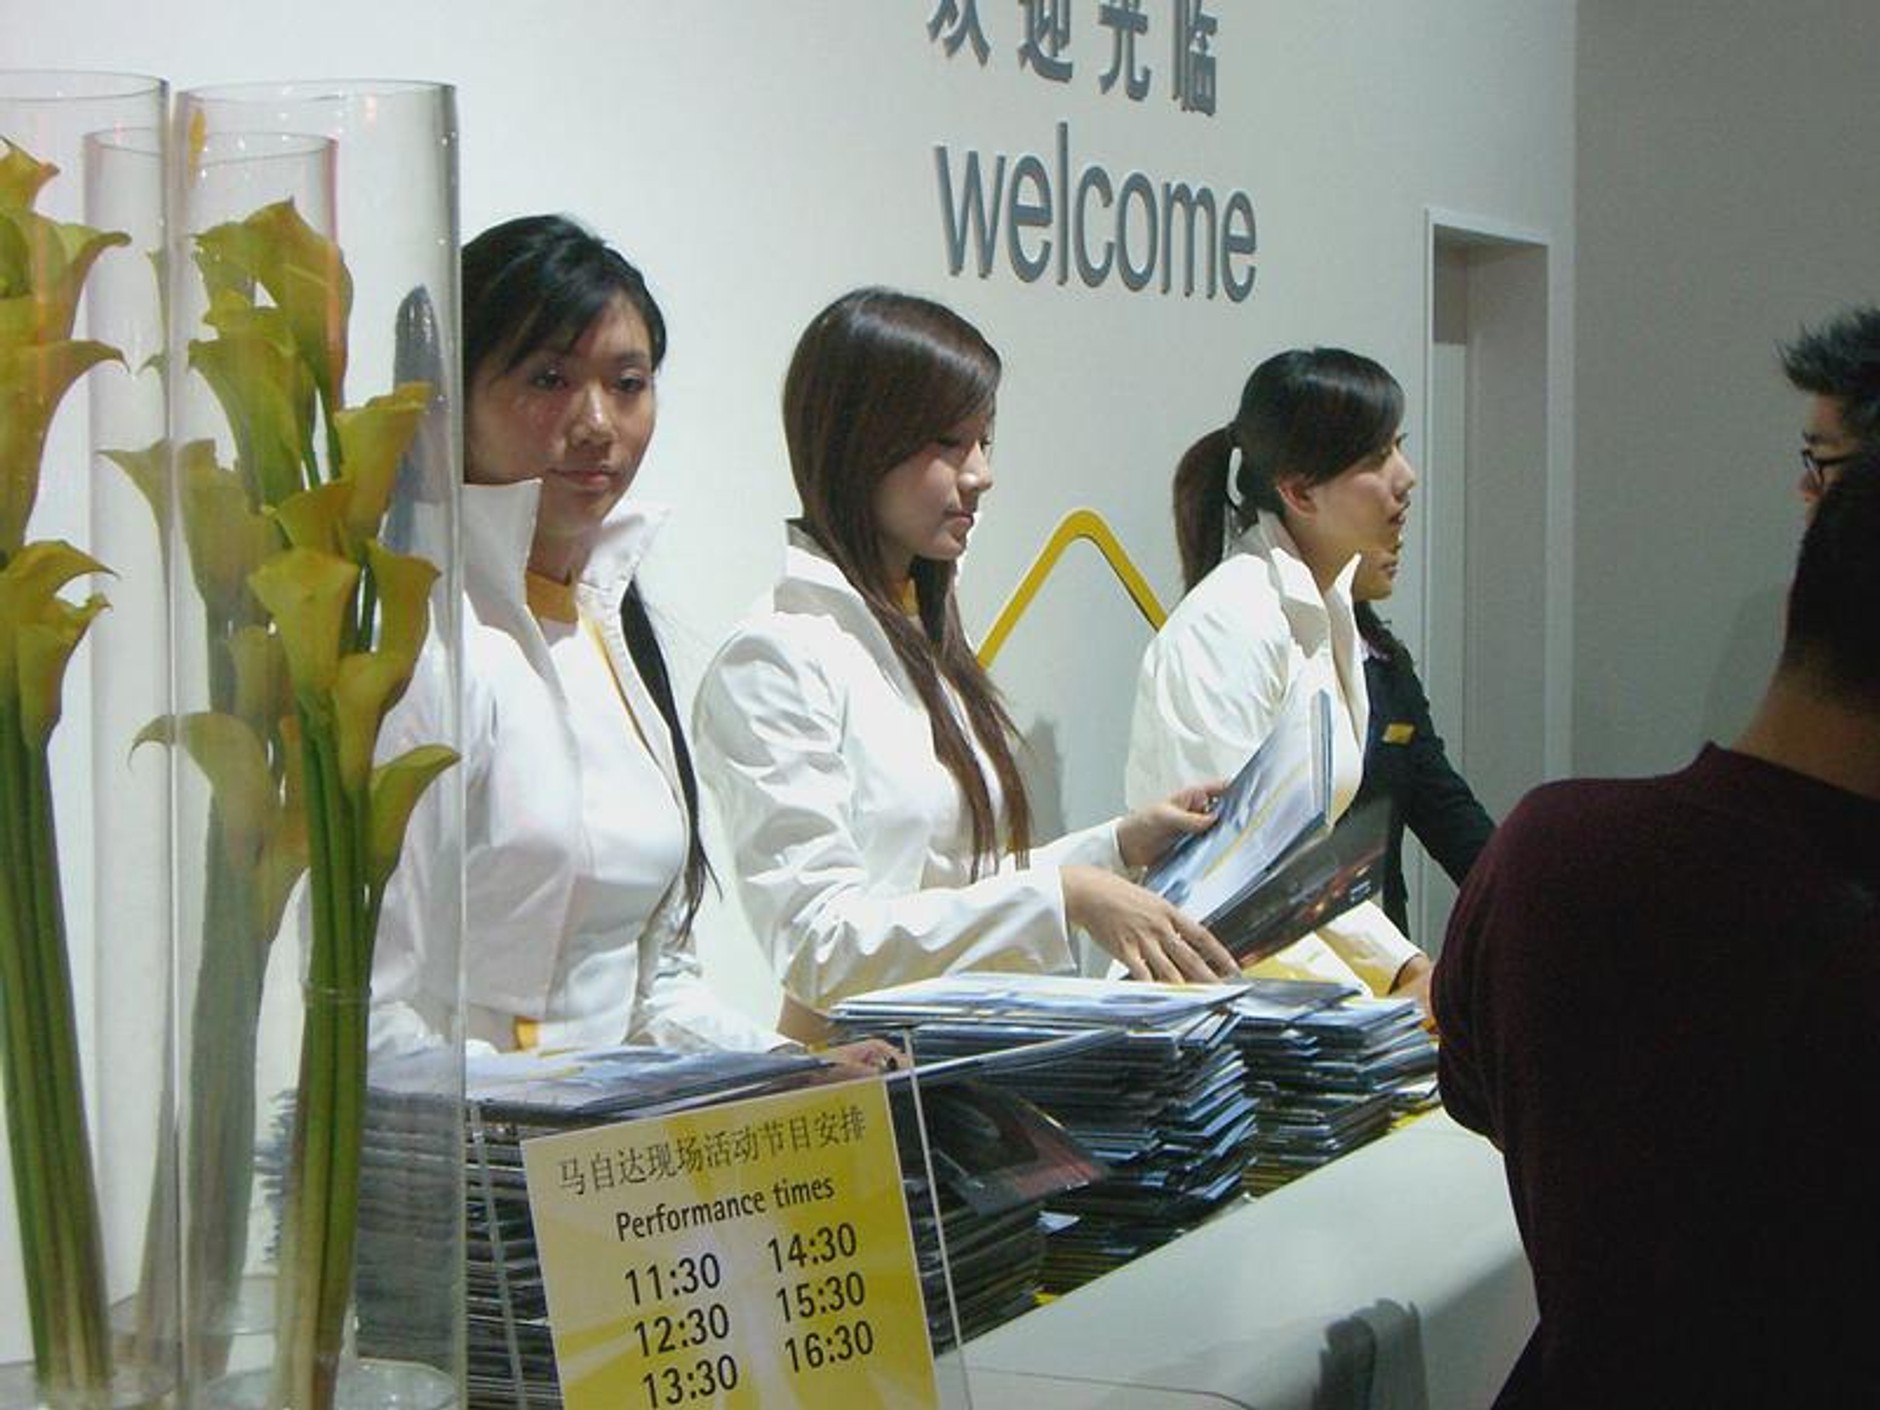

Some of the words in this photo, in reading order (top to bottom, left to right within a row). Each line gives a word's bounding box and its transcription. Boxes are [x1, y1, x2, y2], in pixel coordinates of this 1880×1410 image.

[934, 121, 1257, 302] welcome
[558, 1106, 866, 1196] 马自达现场活动节目安排
[616, 1188, 767, 1241] Performance
[773, 1174, 835, 1209] times
[625, 1252, 721, 1305] 11:30
[768, 1222, 857, 1273] 14:30
[634, 1303, 730, 1358] 12:30
[777, 1271, 866, 1323] 15:30
[643, 1355, 739, 1410] 13:30
[785, 1320, 874, 1373] 16:30
